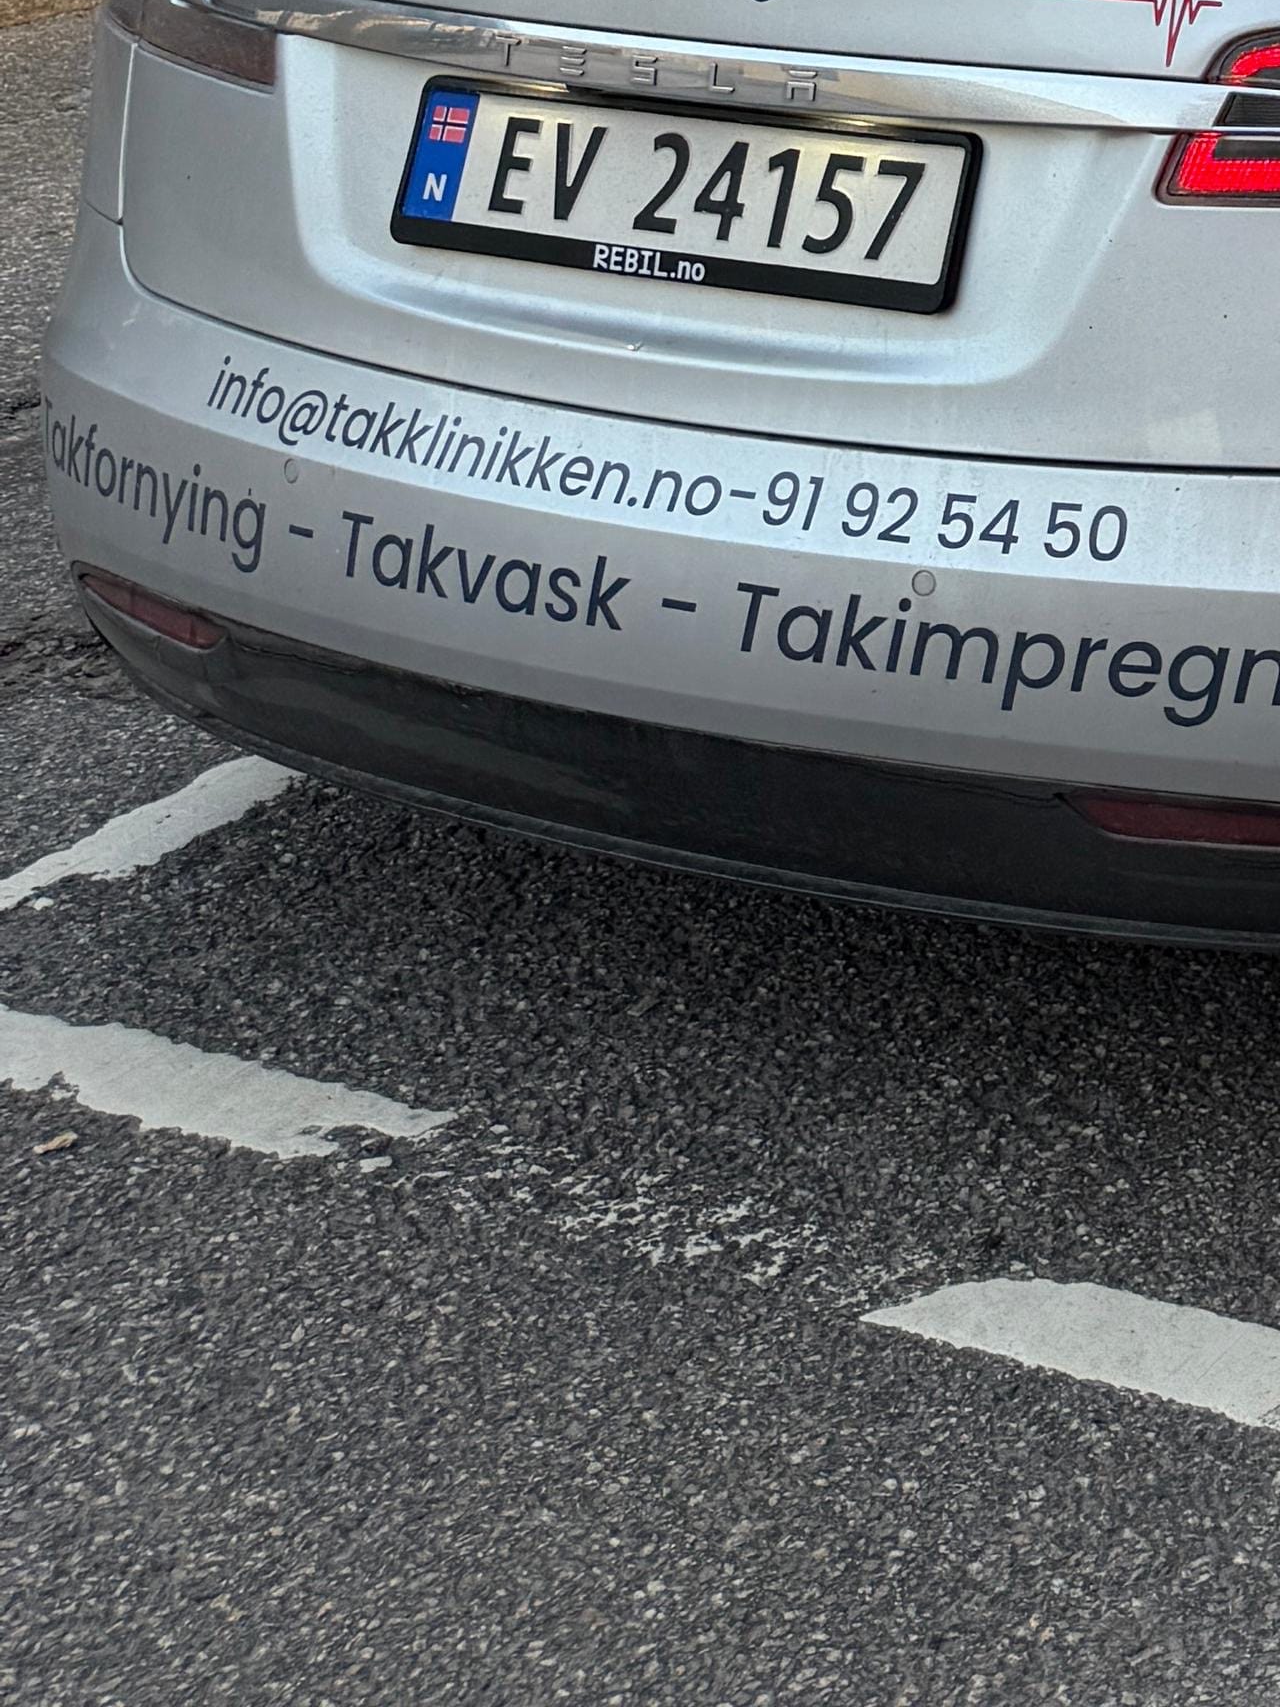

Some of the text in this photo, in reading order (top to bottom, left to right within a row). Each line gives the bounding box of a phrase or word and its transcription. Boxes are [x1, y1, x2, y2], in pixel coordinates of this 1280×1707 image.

[494, 35, 818, 102] TESLA
[421, 172, 447, 202] N
[487, 116, 927, 261] EV 24157
[592, 243, 706, 283] REBIL.no
[841, 481, 919, 544] 92
[937, 492, 1021, 555] 54
[1043, 500, 1129, 562] 50
[341, 510, 632, 632] Takvask
